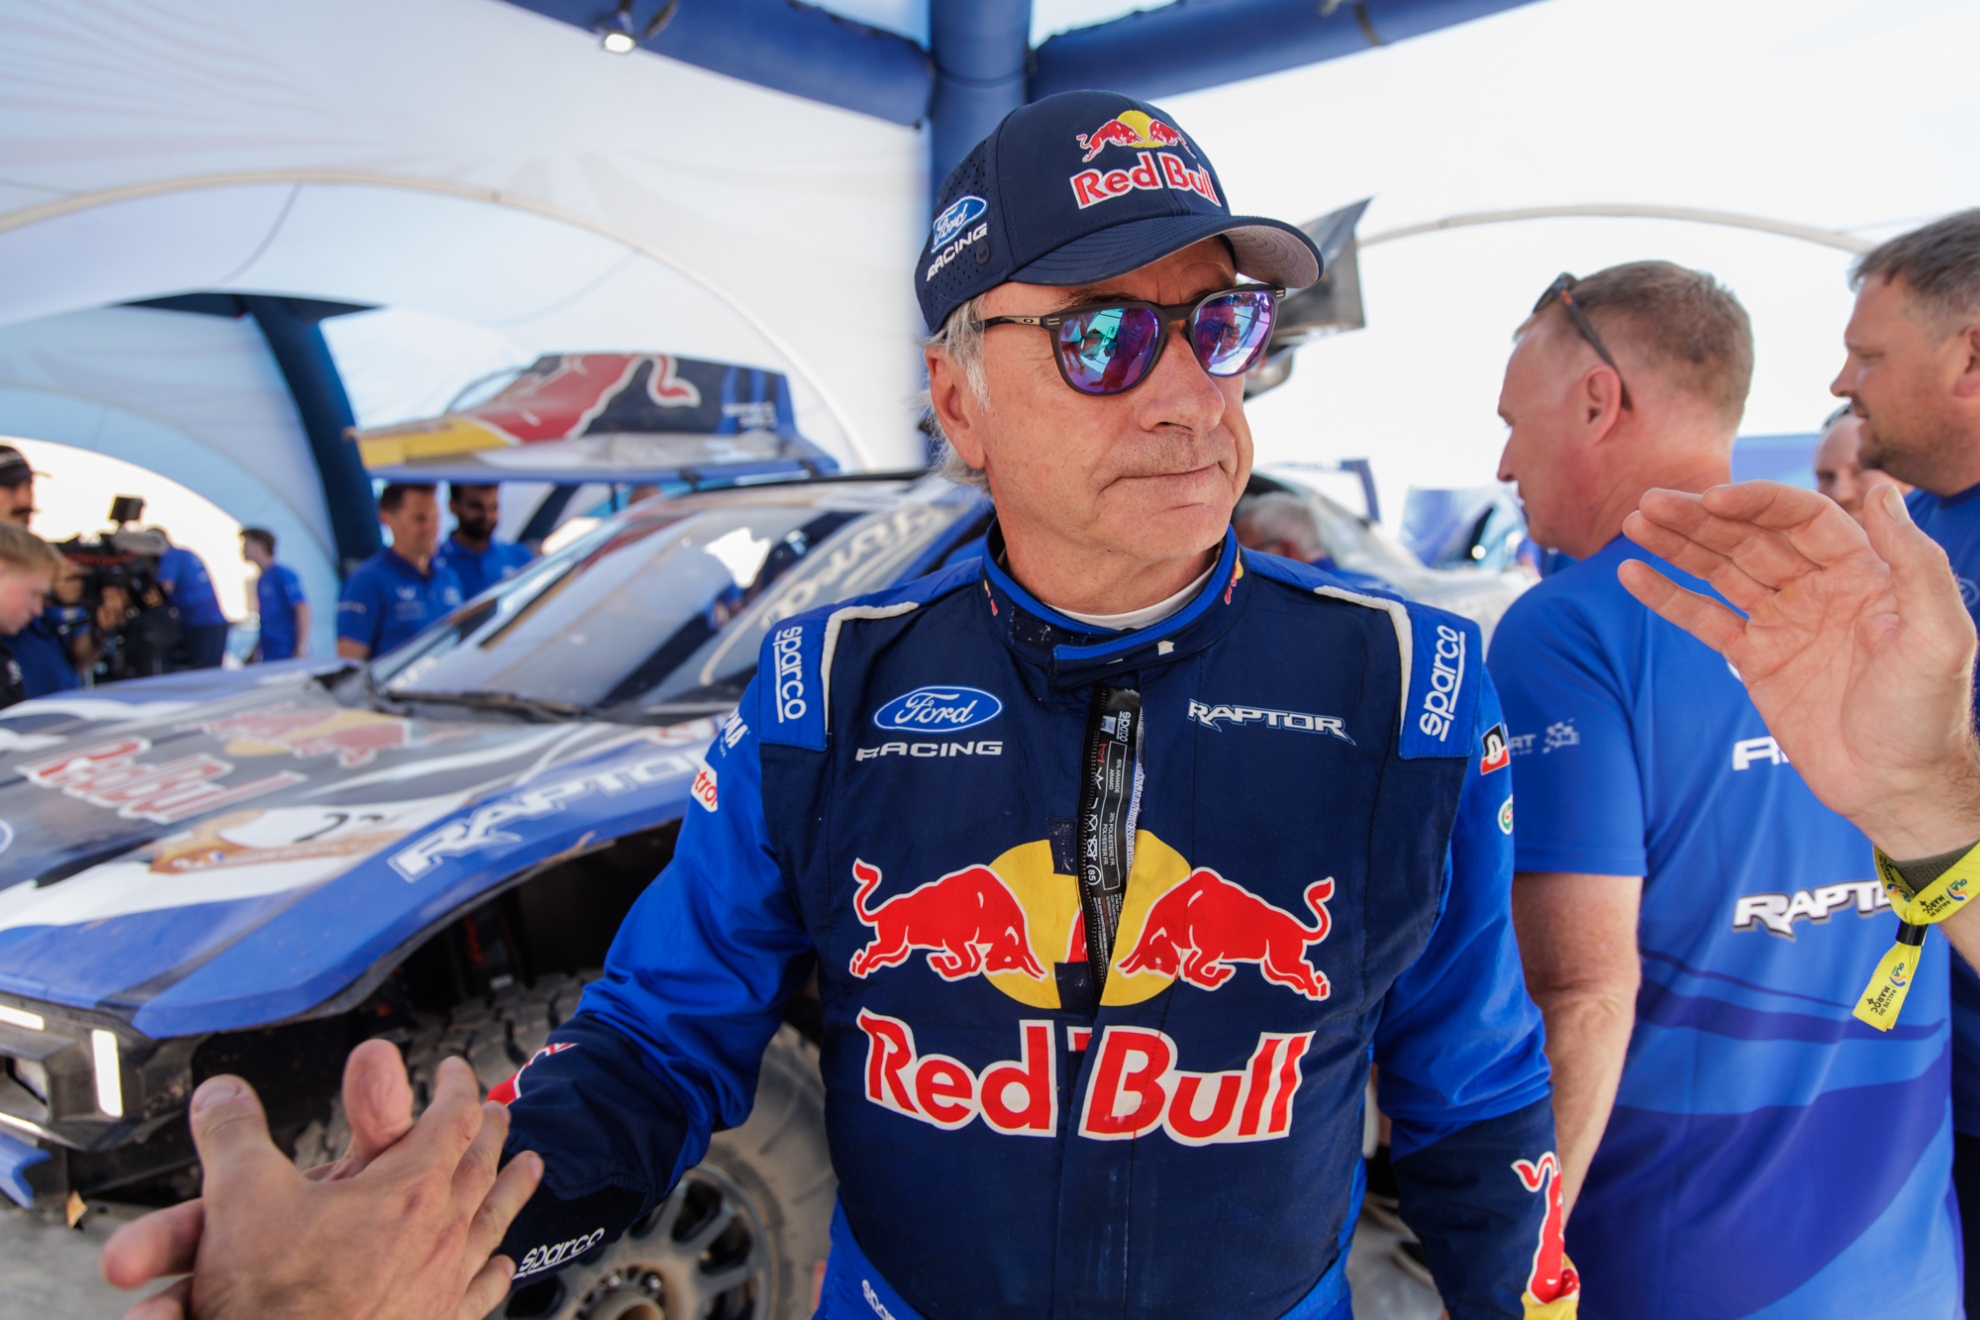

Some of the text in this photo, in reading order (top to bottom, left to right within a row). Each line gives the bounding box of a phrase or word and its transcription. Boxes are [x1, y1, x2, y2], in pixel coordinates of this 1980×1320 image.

[1070, 151, 1222, 209] Red Bull
[932, 202, 968, 247] Ford
[926, 222, 988, 282] RACING
[773, 626, 807, 723] sparco
[1419, 624, 1466, 742] sparco
[894, 691, 979, 725] Ford
[1187, 699, 1357, 746] RAPTOR
[855, 740, 1004, 763] RACING
[386, 748, 705, 884] RAPTO
[1087, 869, 1097, 881] 85
[1870, 985, 1891, 1014] MAROC
[856, 1007, 1317, 1147] Red Bull
[511, 1227, 606, 1280] sparco
